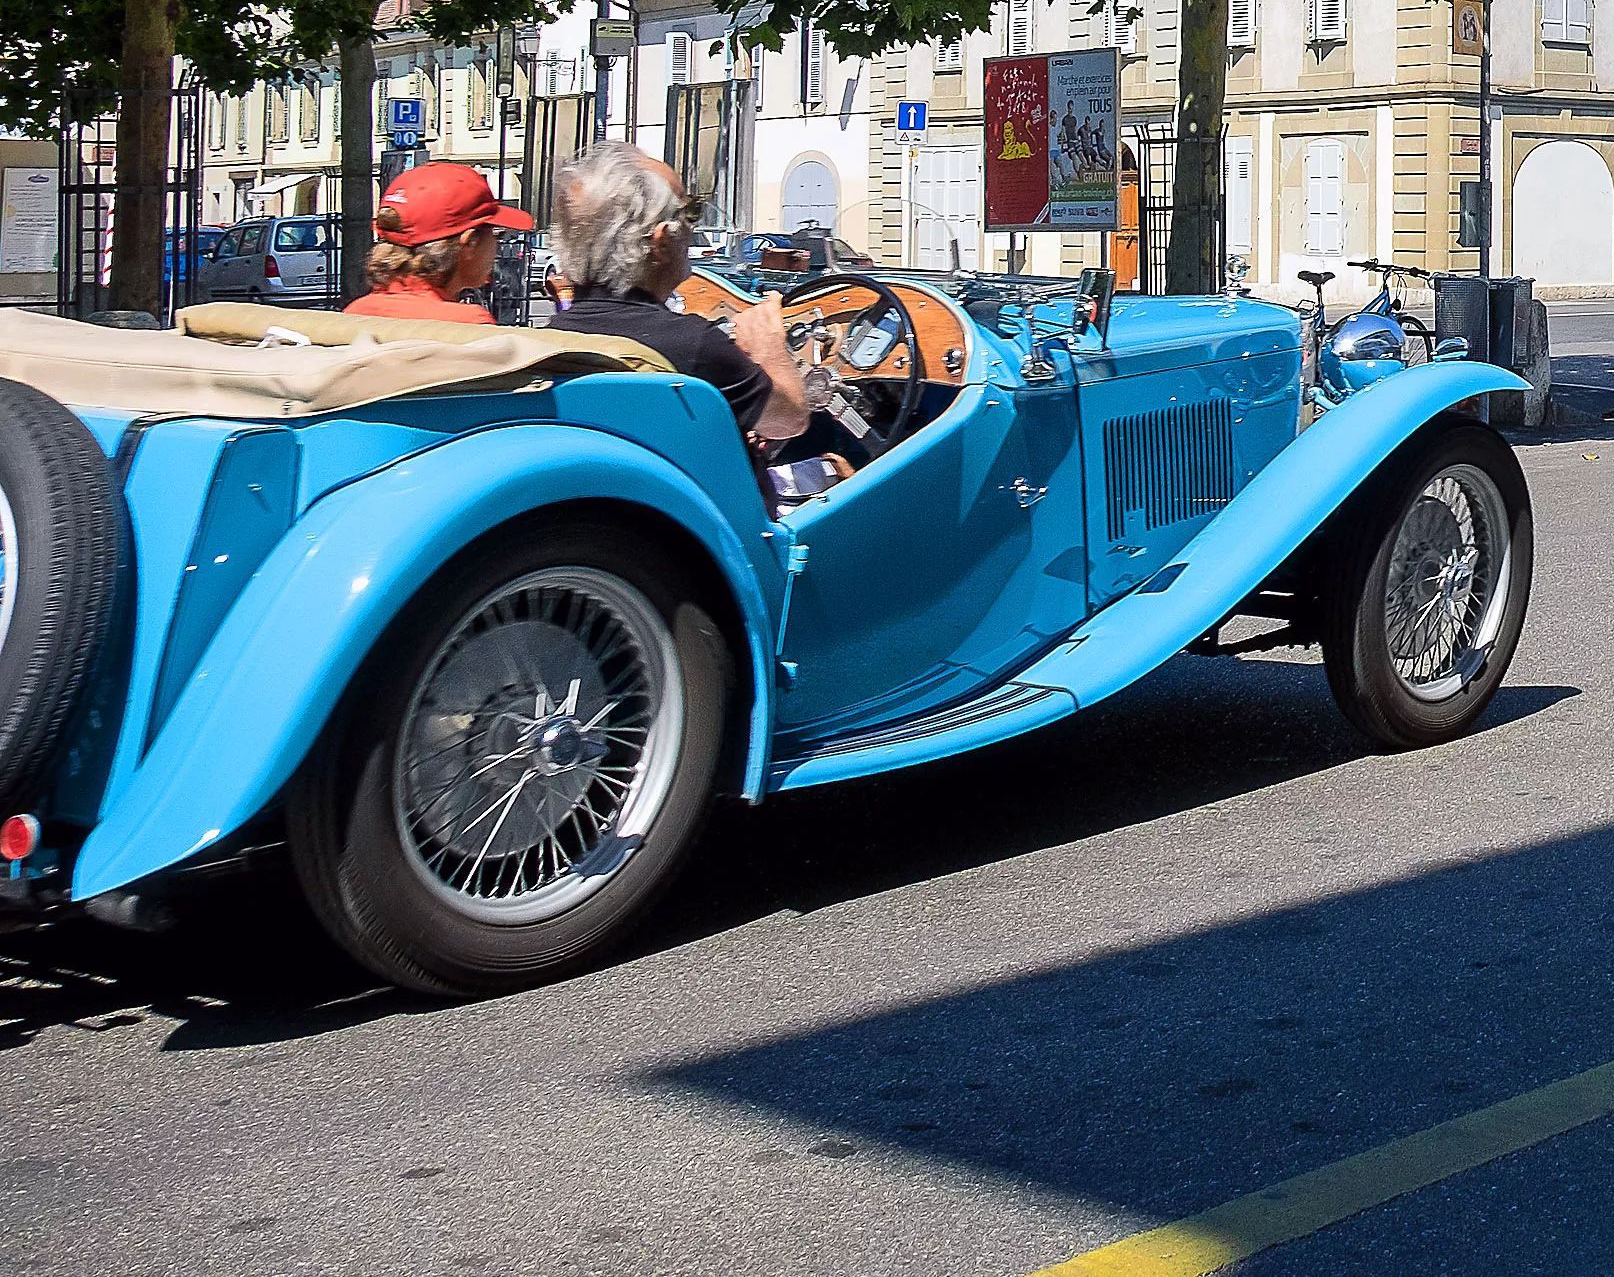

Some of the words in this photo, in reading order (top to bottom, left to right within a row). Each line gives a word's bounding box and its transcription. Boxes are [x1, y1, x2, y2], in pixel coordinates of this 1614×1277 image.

[1058, 75, 1078, 86] Marche
[1085, 74, 1112, 84] exercices
[399, 103, 411, 119] P
[1088, 98, 1112, 113] TOUS
[1083, 172, 1114, 183] GRATUIT
